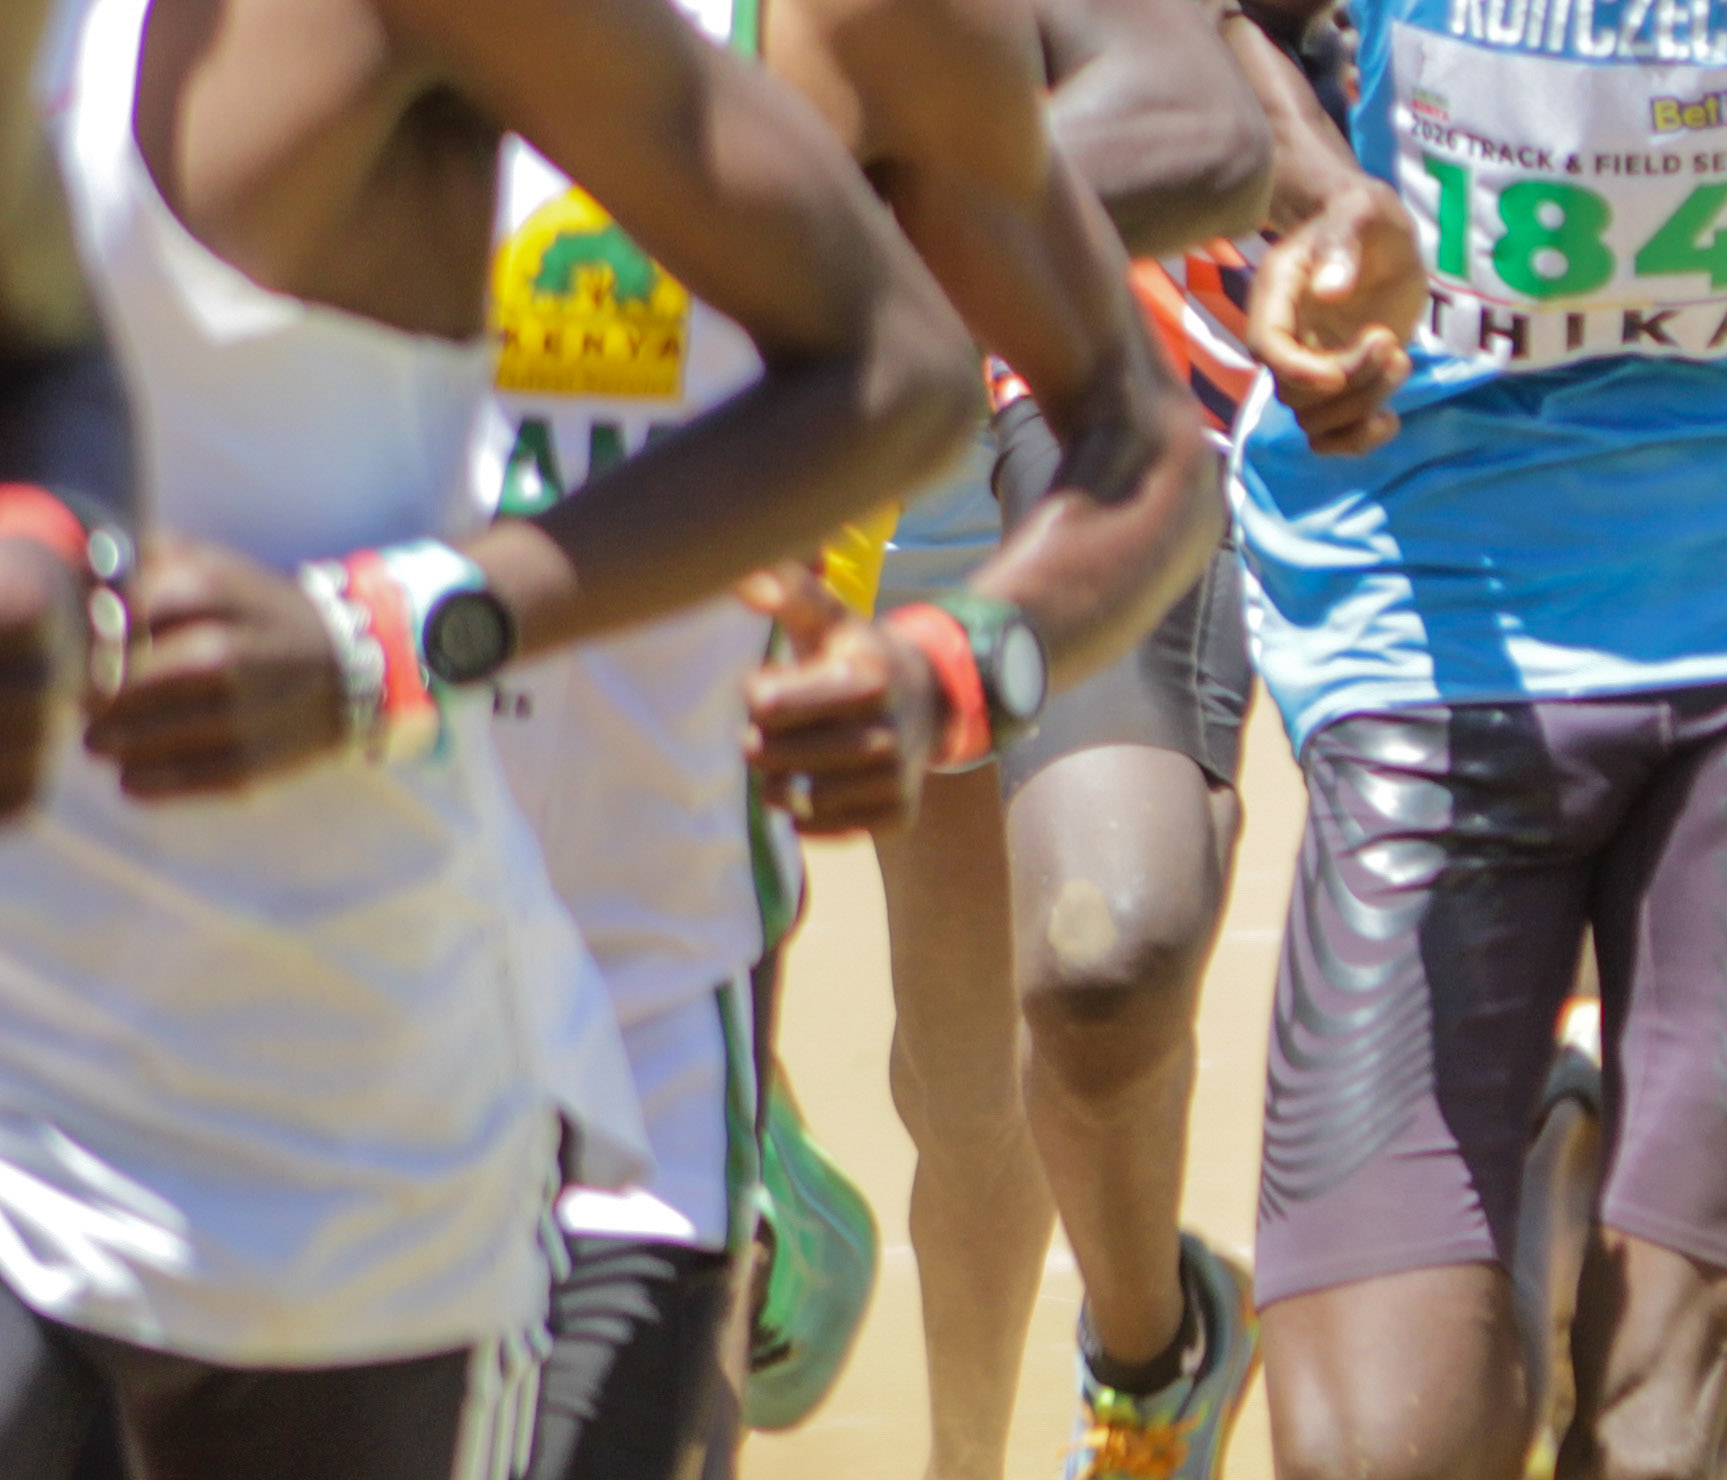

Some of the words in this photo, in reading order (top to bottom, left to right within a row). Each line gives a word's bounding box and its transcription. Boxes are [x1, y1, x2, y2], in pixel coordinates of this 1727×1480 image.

[1462, 129, 1554, 173] TRACK
[1565, 152, 1583, 175] &
[1594, 152, 1682, 177] FIELD
